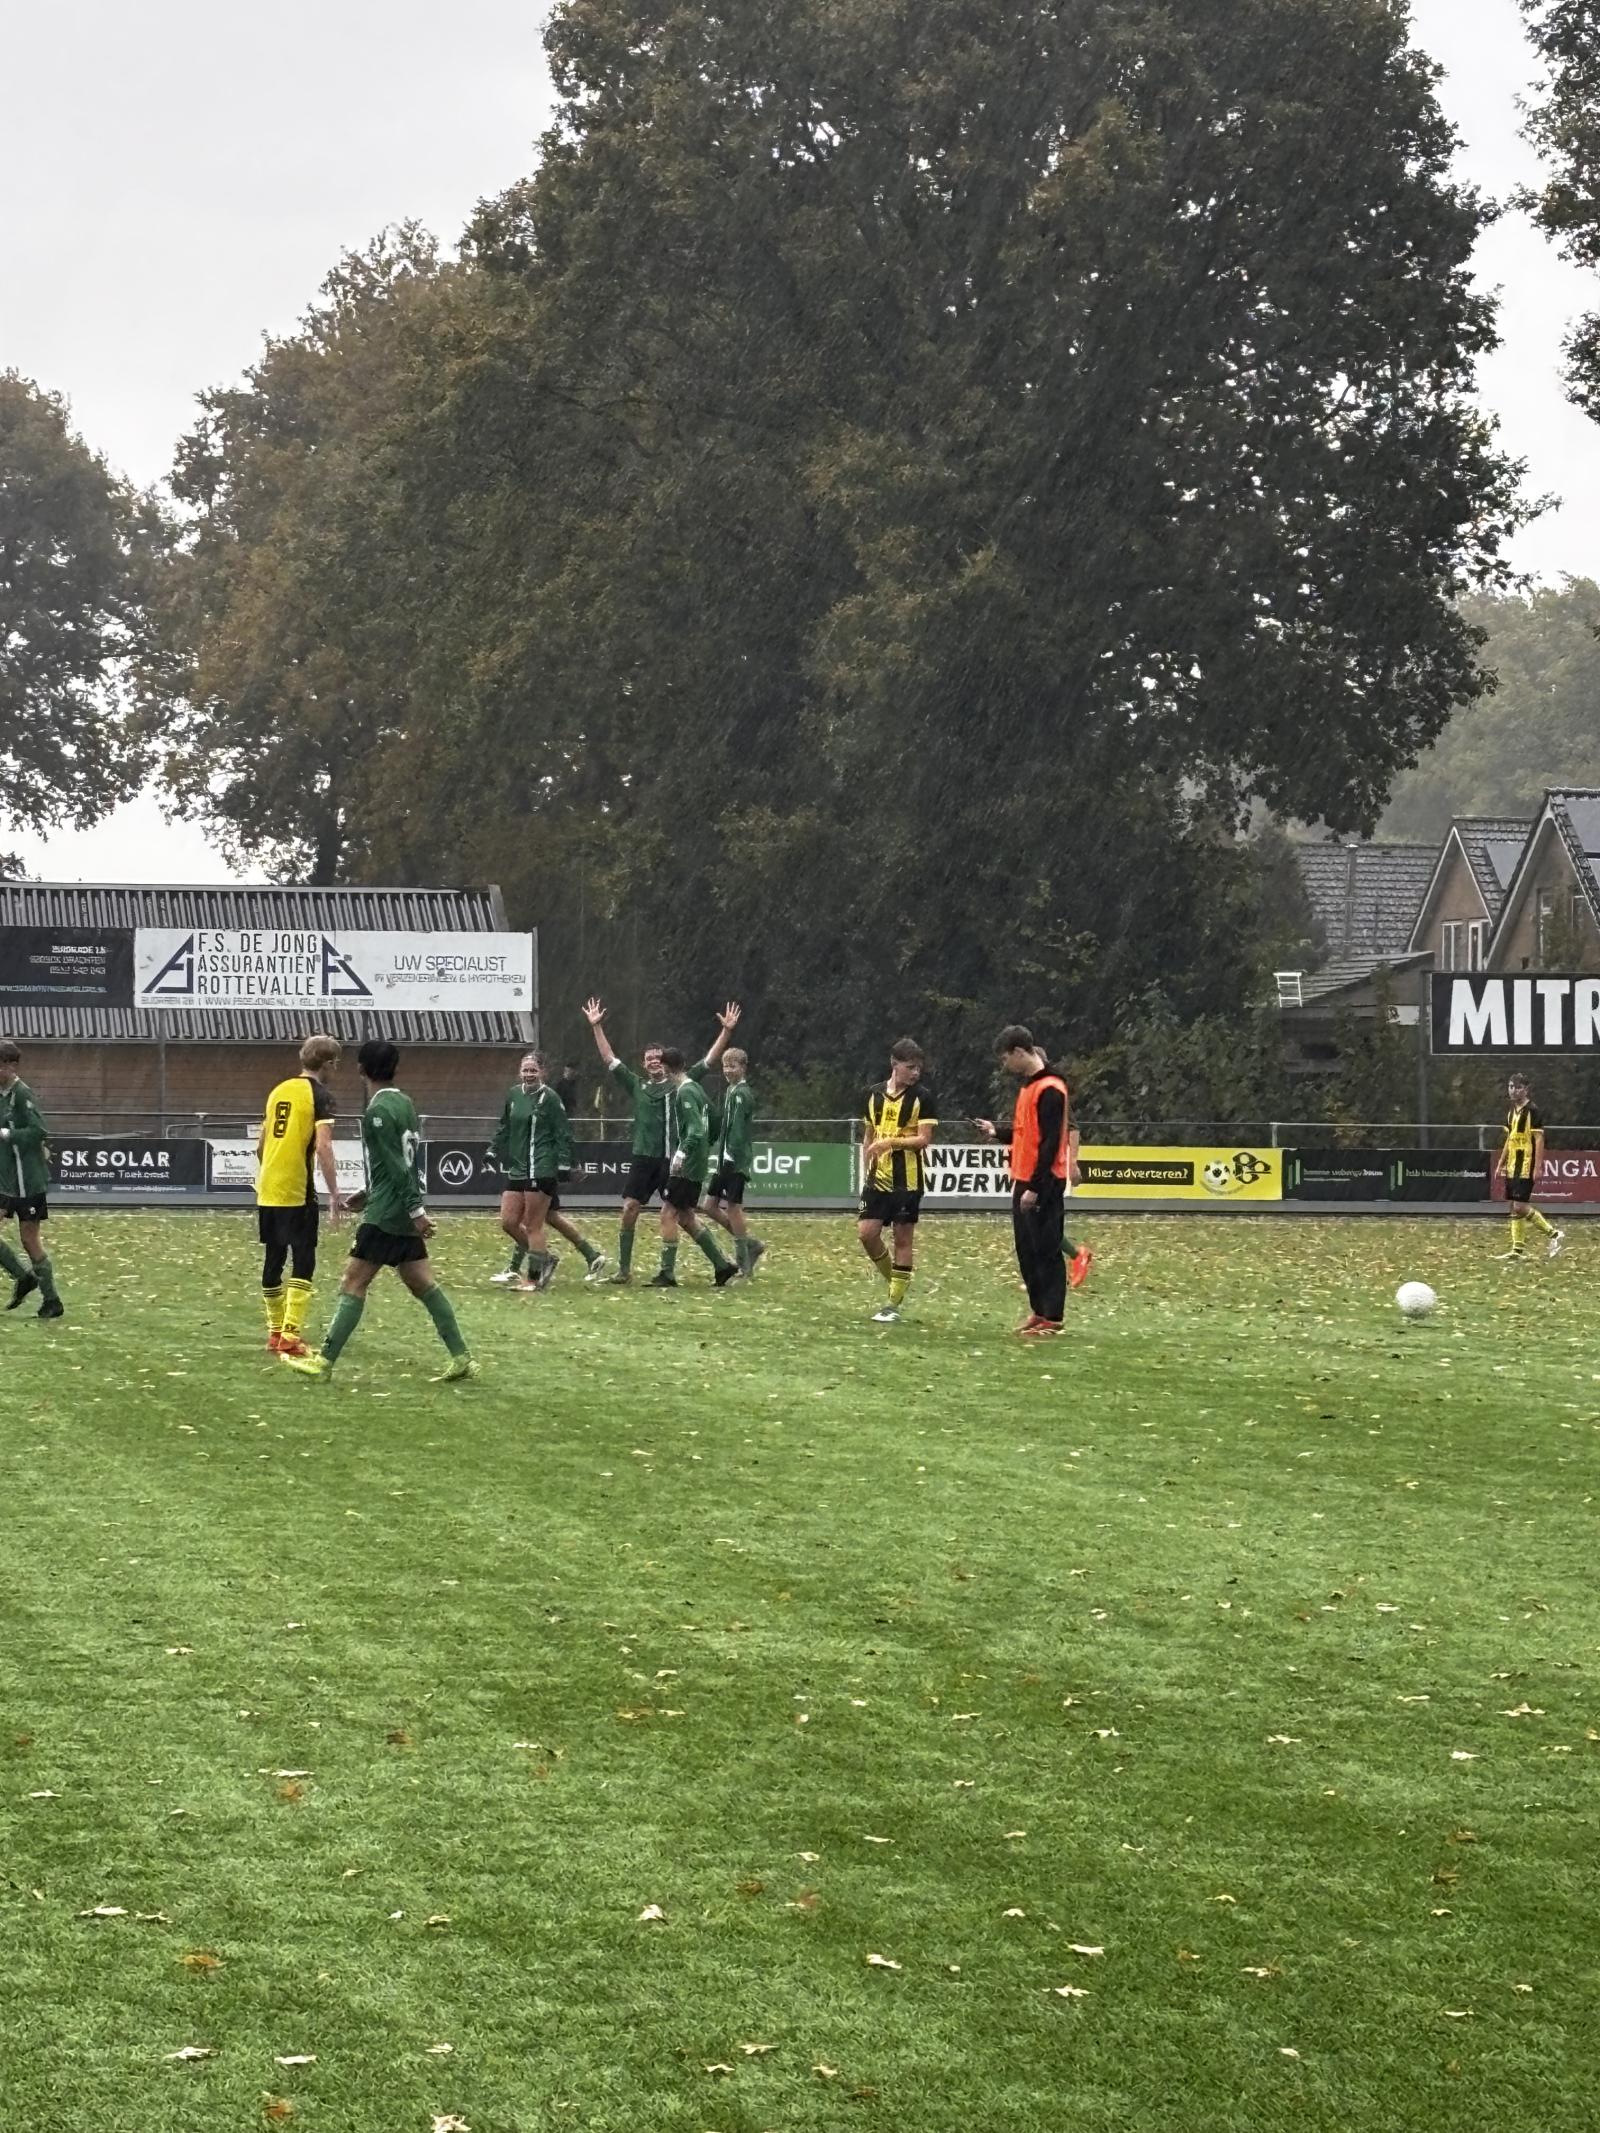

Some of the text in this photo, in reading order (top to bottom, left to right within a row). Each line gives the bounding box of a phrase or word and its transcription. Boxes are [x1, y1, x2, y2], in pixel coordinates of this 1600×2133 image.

[198, 933, 317, 954] F.S. DE JONG
[394, 955, 507, 971] UW SPECIALIST
[198, 975, 316, 996] ROTTEVALLE
[1448, 978, 1600, 1045] MITR
[273, 1101, 291, 1138] 8
[61, 1150, 171, 1168] SK SOLAR
[748, 1148, 811, 1174] der
[1543, 1159, 1598, 1177] NGA
[941, 1174, 987, 1192] DER
